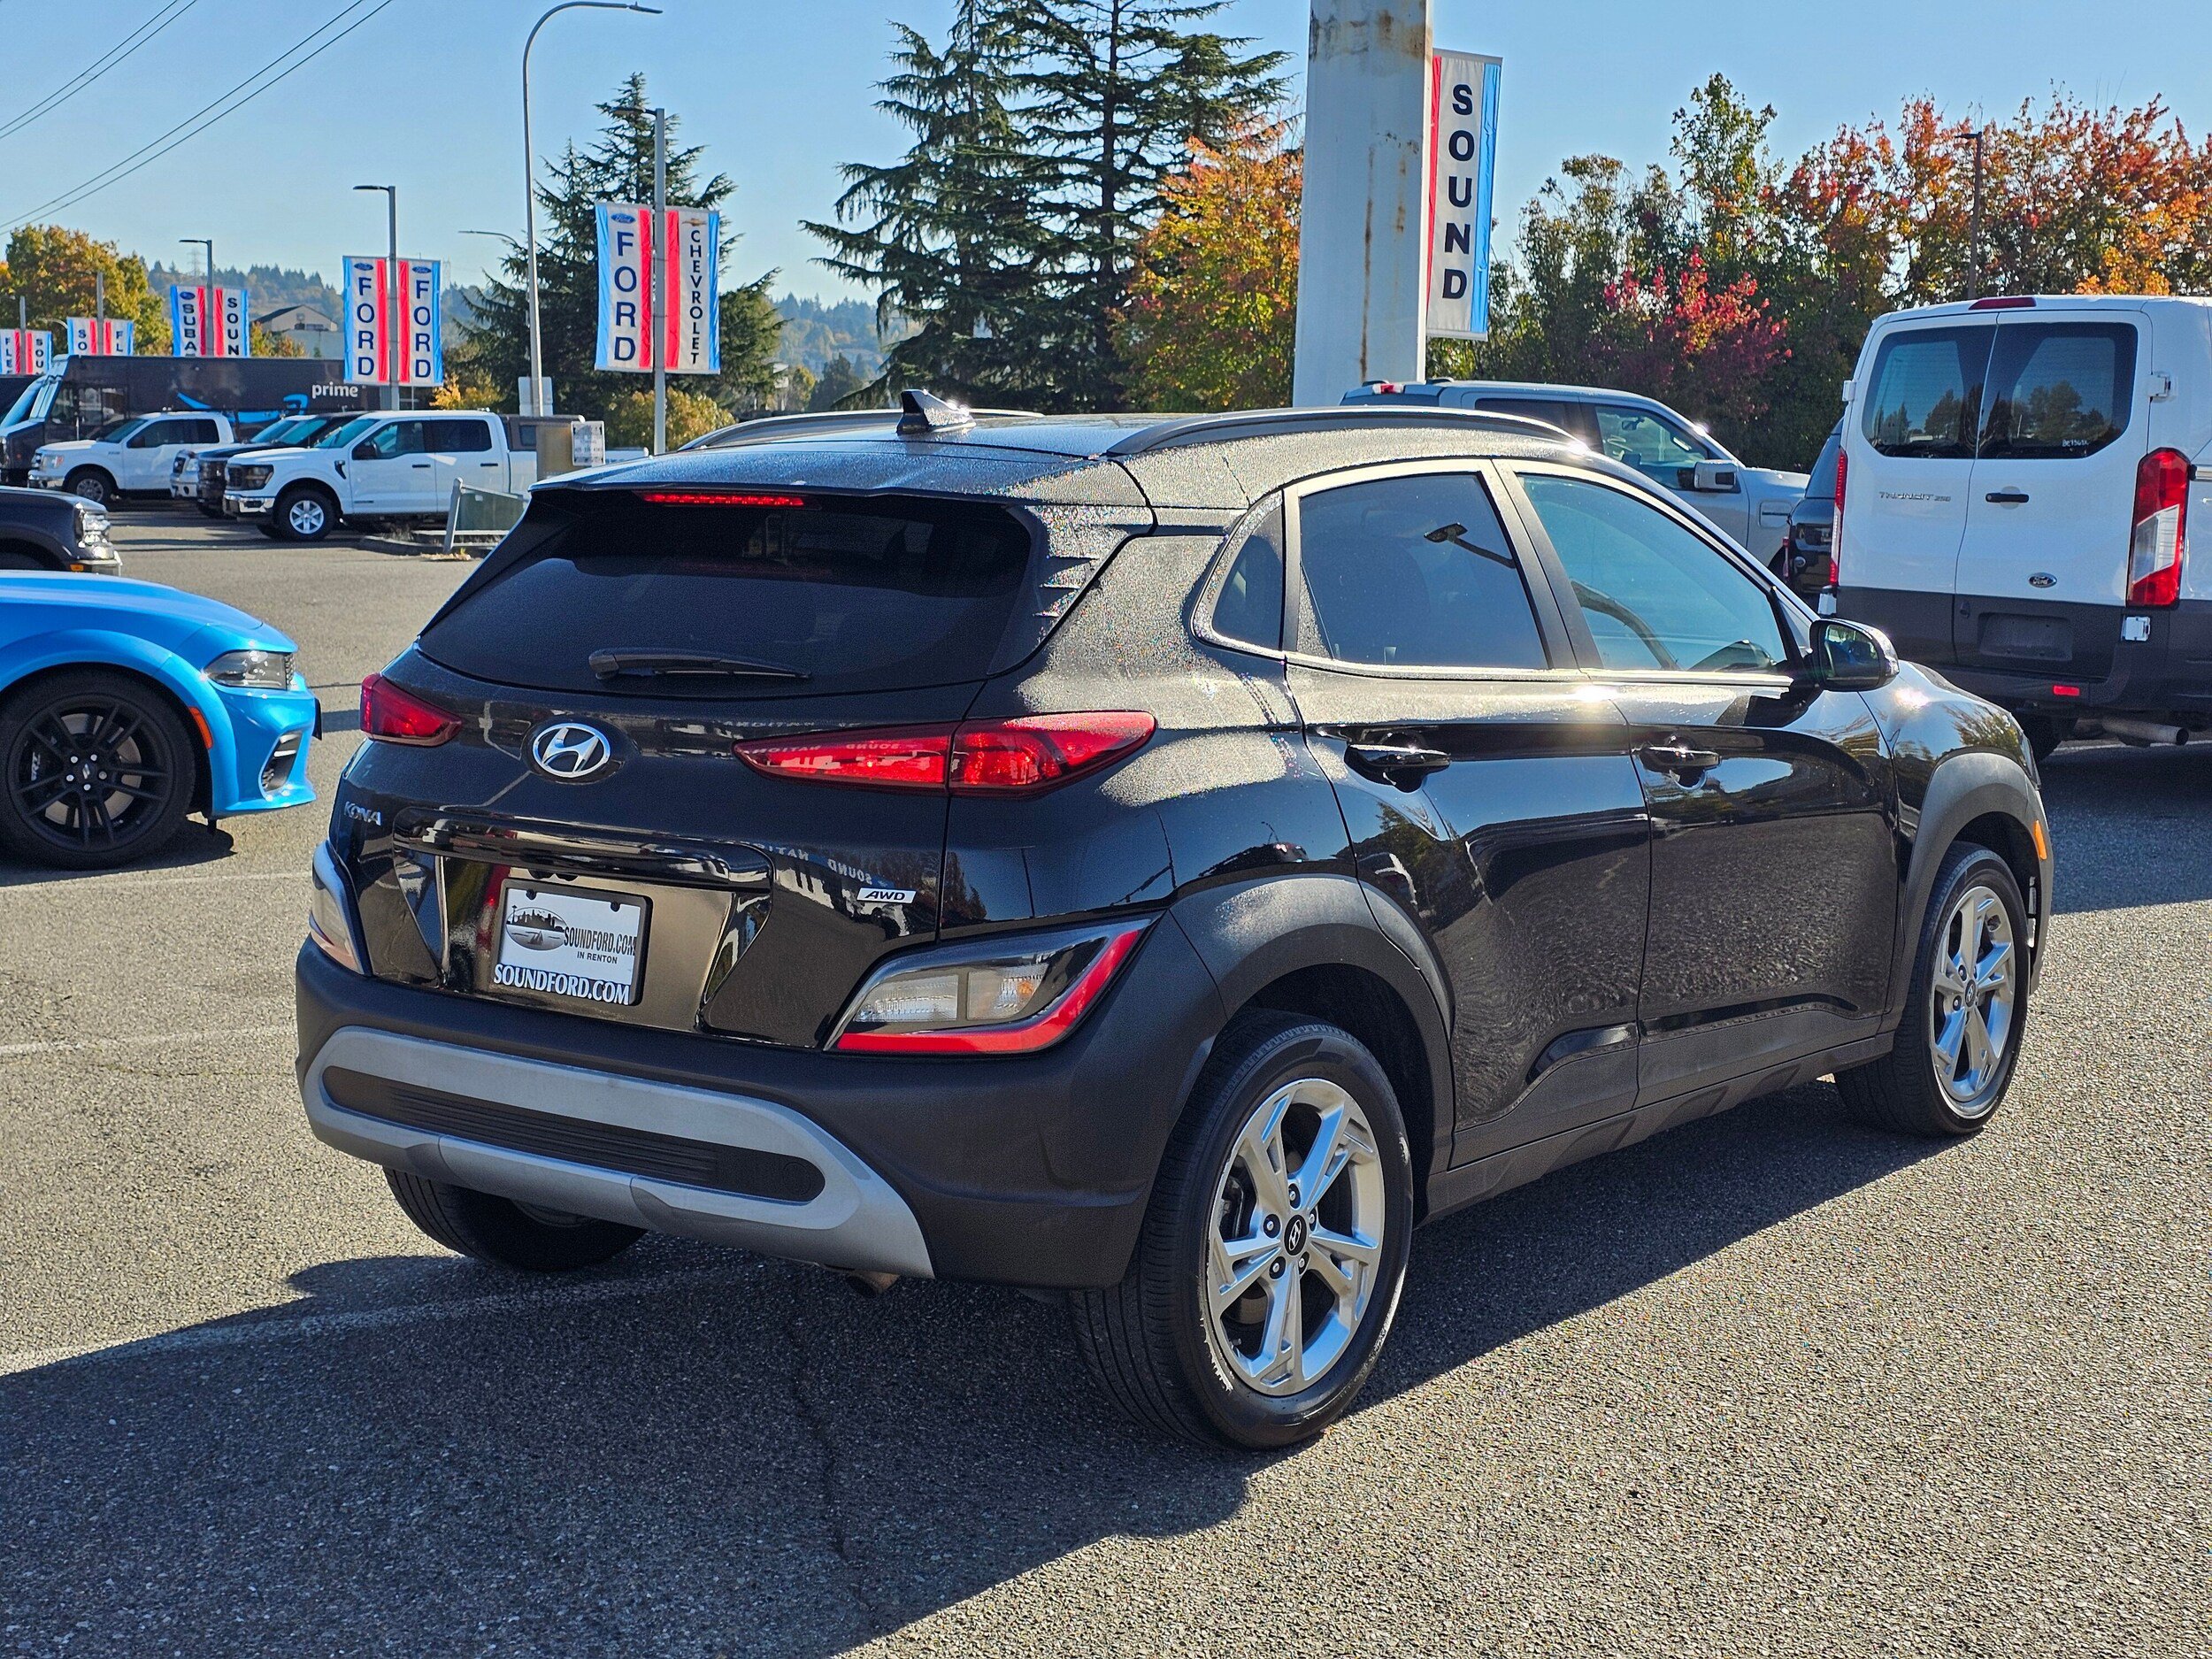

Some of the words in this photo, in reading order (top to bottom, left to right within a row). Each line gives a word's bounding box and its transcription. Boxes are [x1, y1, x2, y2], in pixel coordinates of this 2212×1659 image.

[1441, 83, 1475, 300] SOUND
[613, 231, 637, 362] FORD
[689, 229, 703, 365] CHEVROLET
[182, 303, 196, 357] SUBA
[357, 276, 375, 376] FORD
[413, 280, 432, 379] FORD
[35, 338, 44, 374] SOU
[311, 380, 359, 400] prime
[343, 801, 381, 826] KONA
[864, 890, 906, 902] AWD
[564, 926, 638, 956] SOUNDFORD.COM
[576, 950, 584, 959] IN
[587, 952, 618, 964] RENTON
[493, 963, 631, 1006] SOUNDFORD.COM
